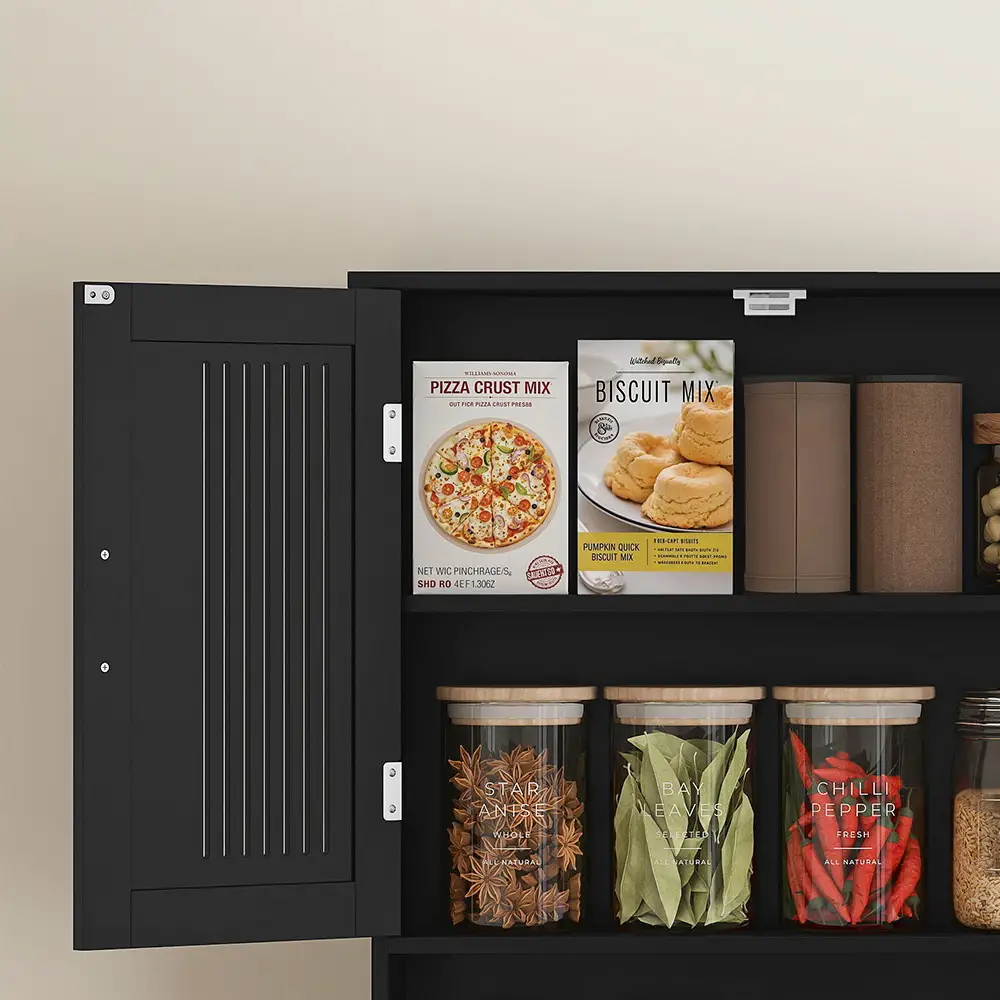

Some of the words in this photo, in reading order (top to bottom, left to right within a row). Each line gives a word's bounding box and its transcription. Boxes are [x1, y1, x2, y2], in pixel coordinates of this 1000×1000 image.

[430, 381, 470, 394] PIZZA
[474, 381, 520, 394] CRUST
[524, 381, 551, 394] MIX
[596, 380, 671, 403] BISCUIT
[682, 380, 715, 403] MIX
[583, 543, 616, 551] PUMPKIN
[618, 543, 640, 551] QUICK
[592, 553, 617, 561] BISCUIT
[620, 553, 633, 561] MIX
[417, 567, 434, 575] NET
[417, 580, 436, 588] SHD
[439, 580, 451, 588] RO
[485, 782, 540, 796] STAR
[662, 782, 704, 795] BAY
[816, 781, 889, 796] CHILLI
[479, 804, 545, 817] ANISE
[643, 803, 723, 817] LEAVES
[811, 803, 896, 817] PEPPER
